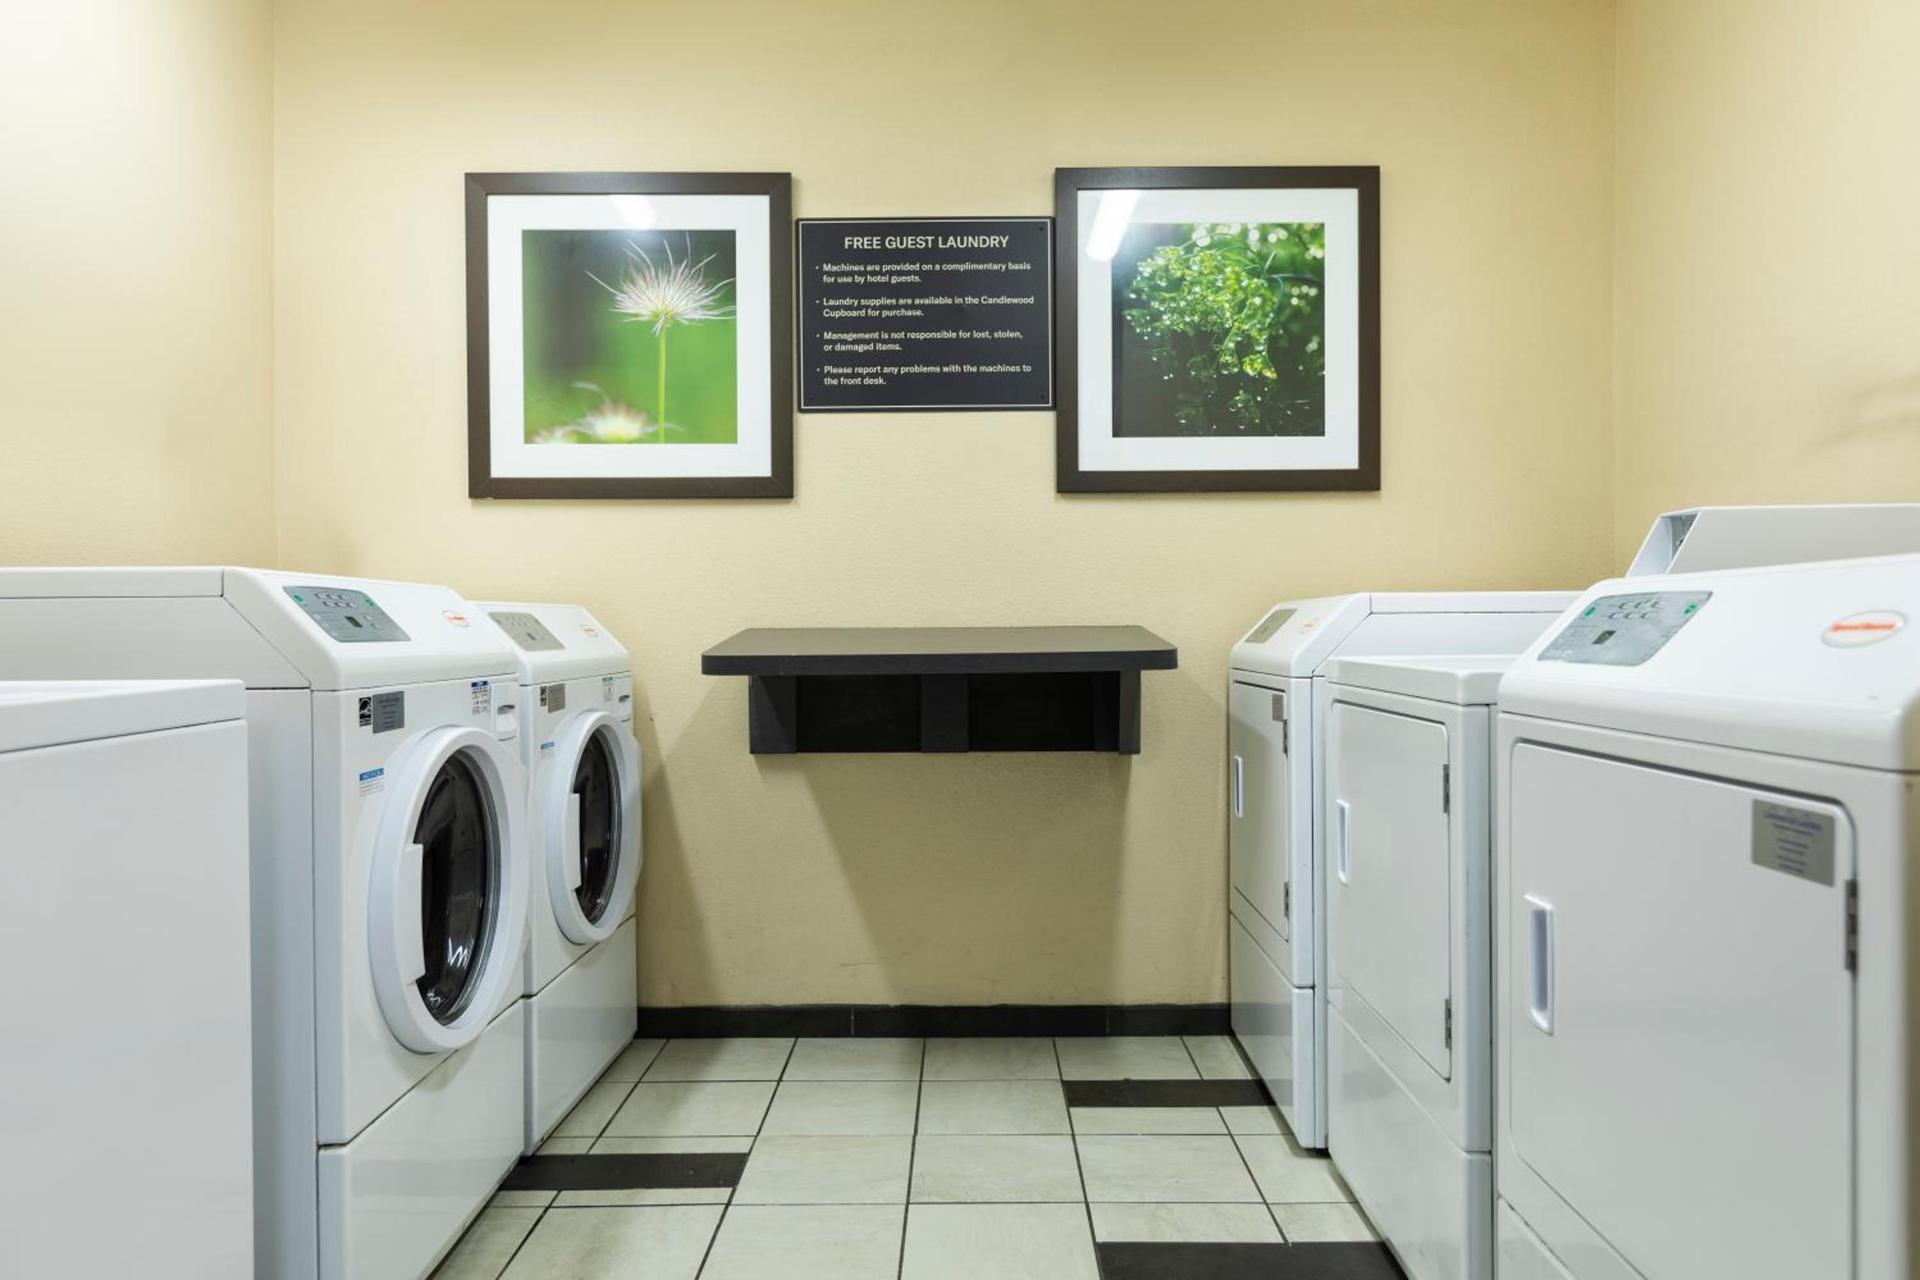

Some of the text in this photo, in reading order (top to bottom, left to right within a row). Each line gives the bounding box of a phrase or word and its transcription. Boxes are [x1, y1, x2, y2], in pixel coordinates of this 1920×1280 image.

[844, 236, 1009, 249] FREE GUEST LAUNDRY
[823, 262, 864, 272] Machines
[866, 264, 880, 272] are
[883, 262, 919, 272] provided
[935, 263, 940, 271] a
[942, 261, 1006, 272] complimentary
[1008, 261, 1031, 271] basis
[823, 274, 835, 284] for
[855, 274, 865, 284] by
[867, 273, 889, 283] hotel
[891, 274, 922, 284] guests.
[823, 295, 1034, 307] Laundry supplies are available in the Candlewood
[823, 307, 924, 318] Cupboard for purchase.
[824, 329, 1023, 341] Management is not responsible for lost, stolen,
[824, 342, 902, 352] or damaged items.
[824, 363, 1032, 375] Please report any problems with the machines to
[824, 376, 886, 386] the front desk.
